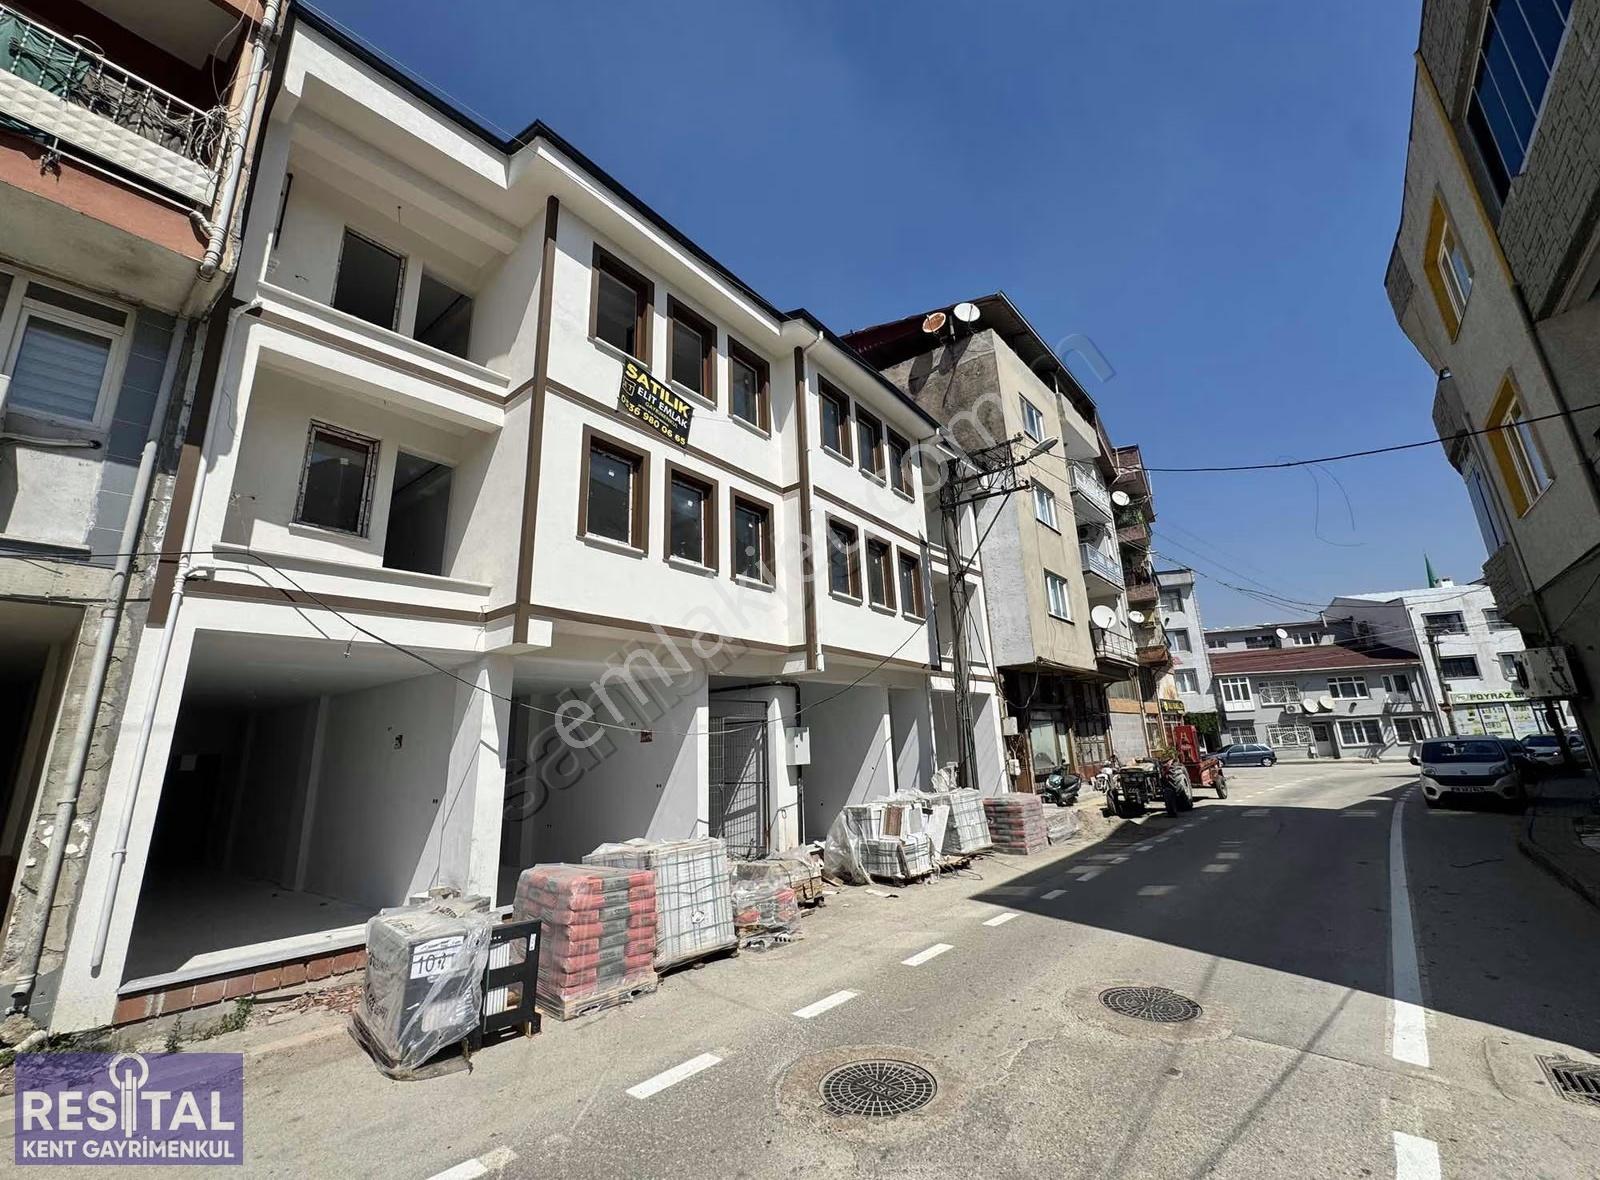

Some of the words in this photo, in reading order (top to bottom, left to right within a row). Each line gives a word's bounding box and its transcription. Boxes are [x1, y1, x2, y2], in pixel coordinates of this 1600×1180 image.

[625, 363, 691, 418] SATILIK
[642, 412, 660, 428] 980
[661, 425, 673, 438] 06
[674, 434, 686, 446] 65
[659, 402, 688, 429] EMLAK
[1470, 692, 1512, 700] POYRAZ
